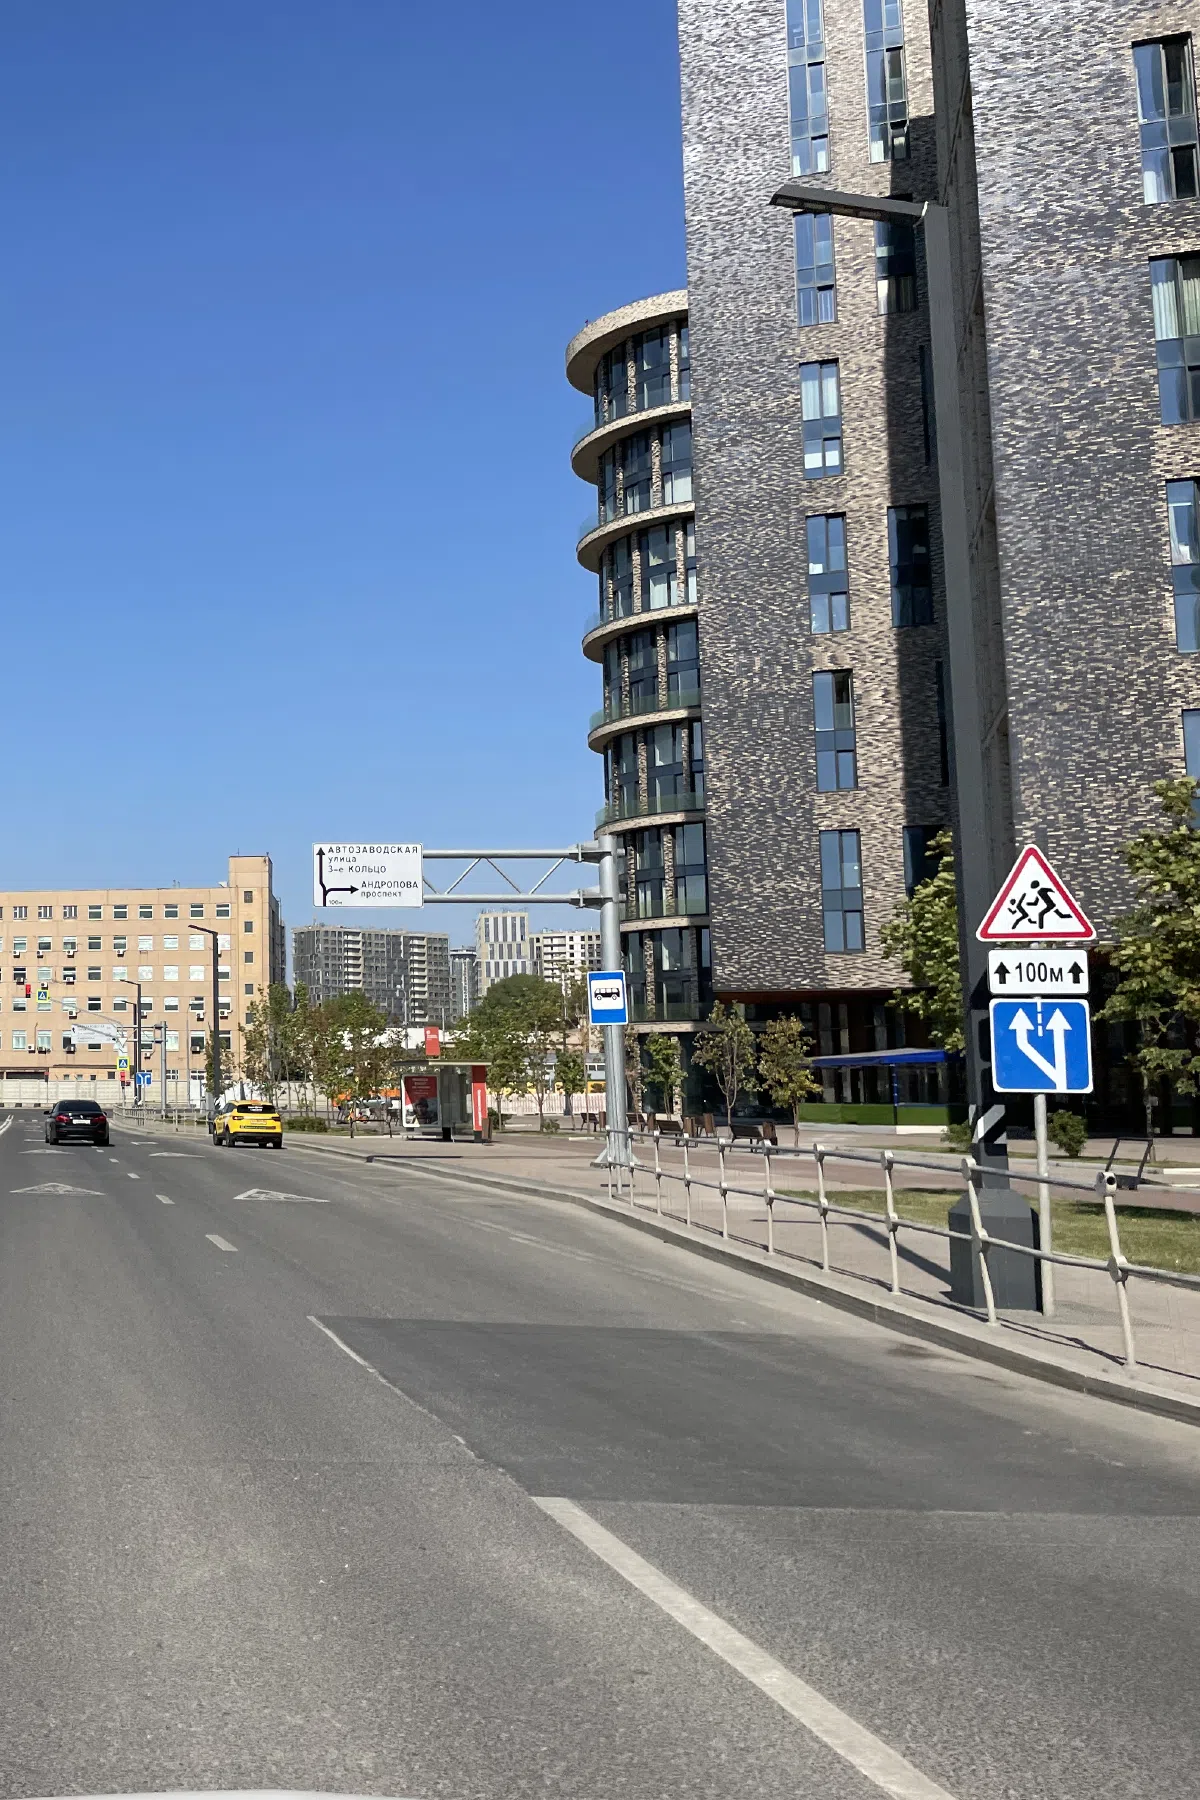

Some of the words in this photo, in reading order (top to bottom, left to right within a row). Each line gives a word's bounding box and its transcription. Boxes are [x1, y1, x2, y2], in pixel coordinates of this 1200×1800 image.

[328, 846, 418, 854] АВТОЗАВОДСКАЯ
[328, 856, 357, 864] улица
[328, 865, 344, 873] 3-е
[348, 865, 387, 874] КОЛЬЦО
[361, 881, 419, 889] АНДРОПОВА
[1015, 961, 1063, 982] 100м
